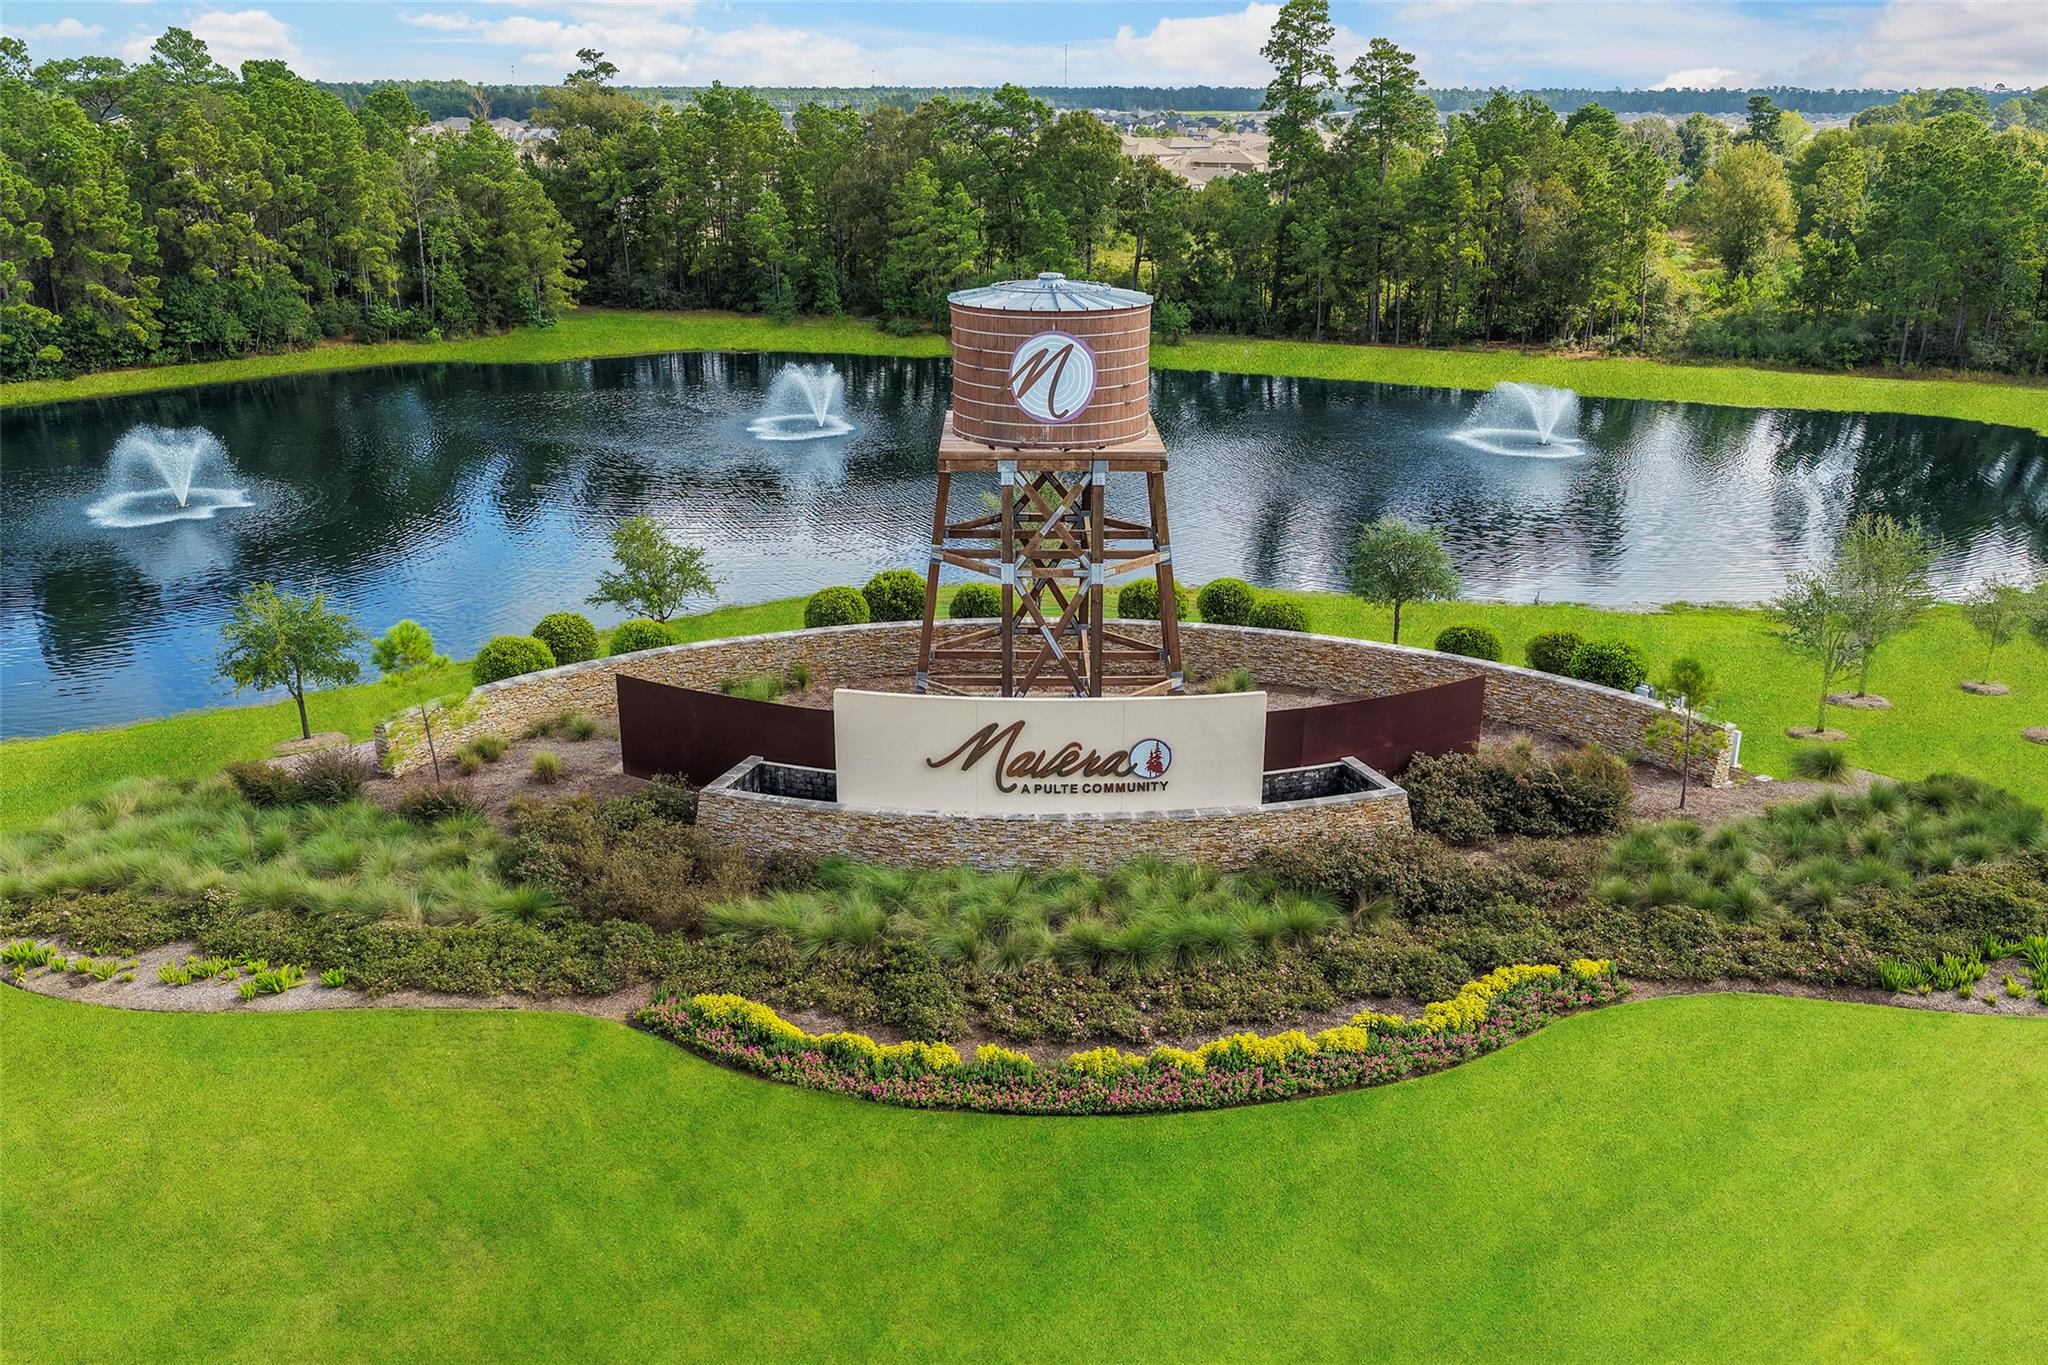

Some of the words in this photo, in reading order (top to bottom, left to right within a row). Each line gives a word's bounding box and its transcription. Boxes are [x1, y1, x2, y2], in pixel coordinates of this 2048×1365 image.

[1020, 783, 1031, 794] A
[1033, 783, 1079, 794] PULTE
[1082, 781, 1169, 793] COMMUNITY
